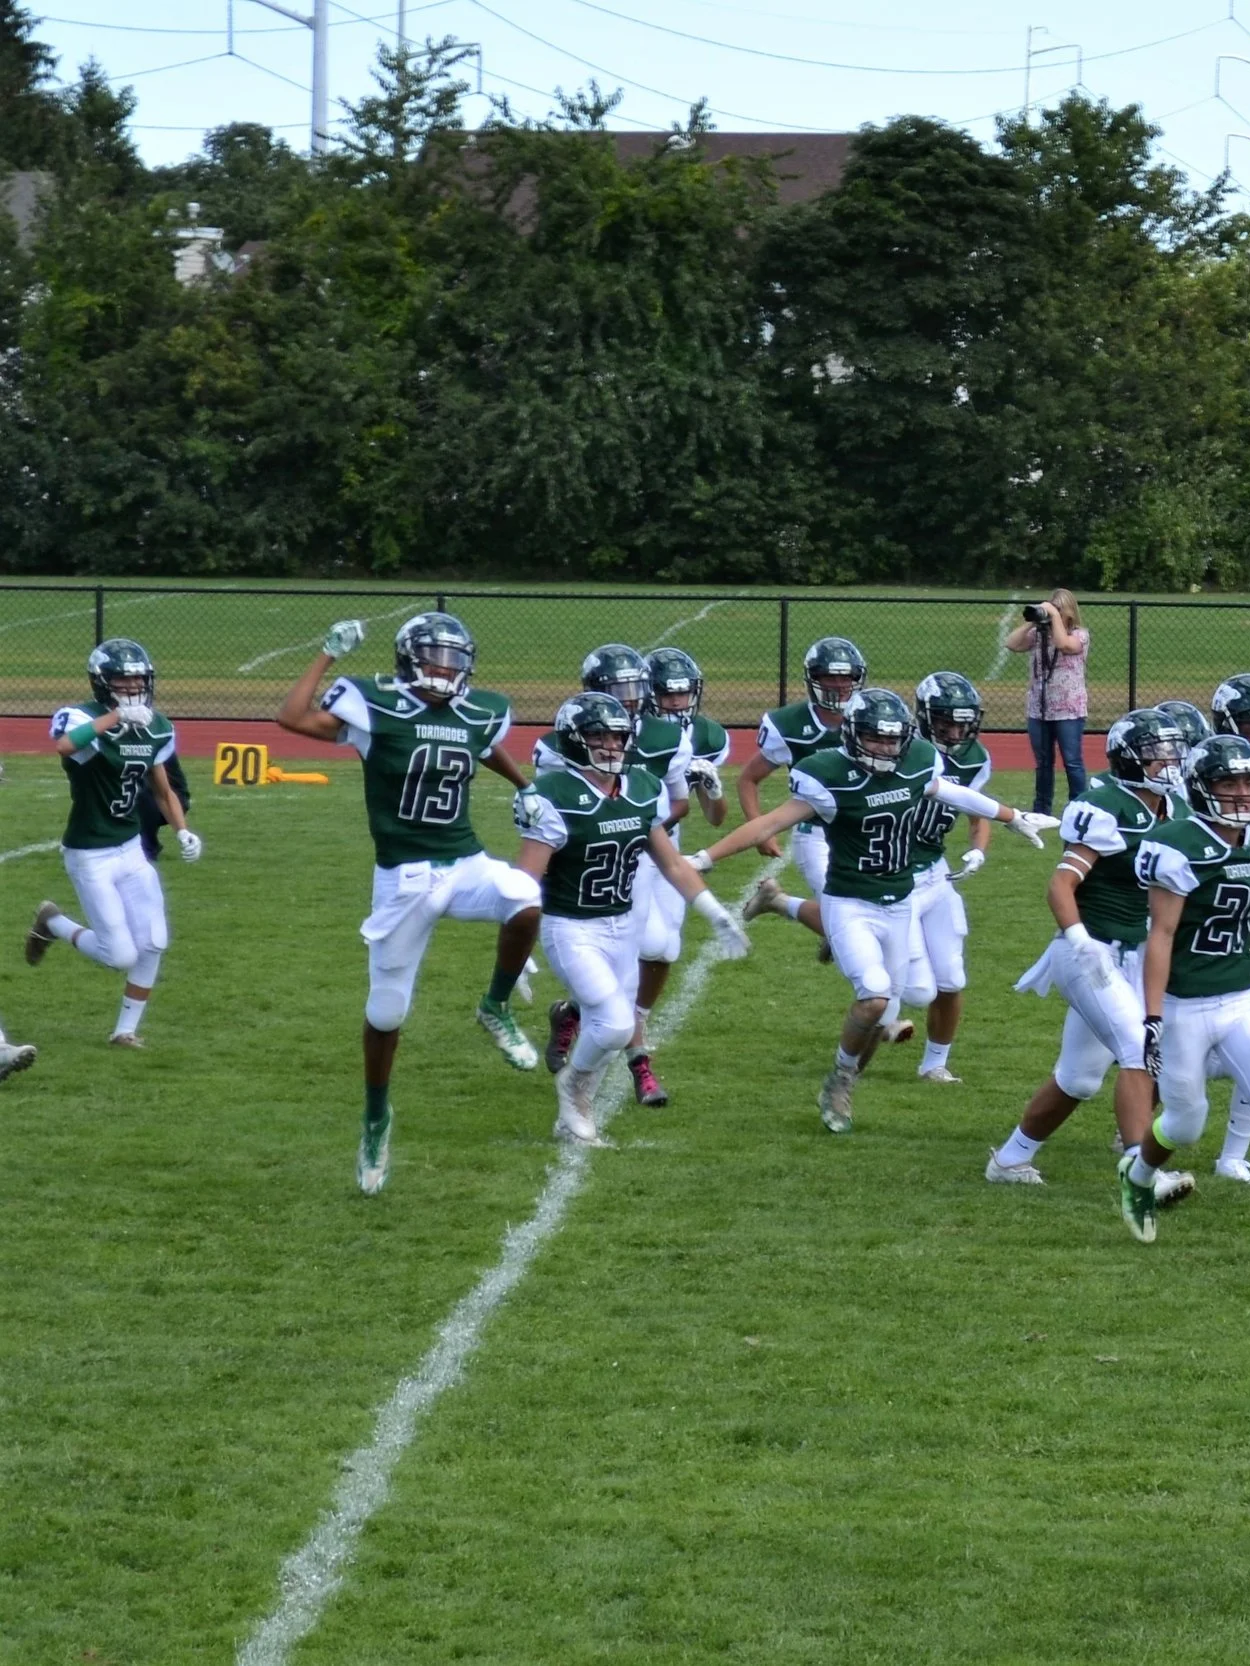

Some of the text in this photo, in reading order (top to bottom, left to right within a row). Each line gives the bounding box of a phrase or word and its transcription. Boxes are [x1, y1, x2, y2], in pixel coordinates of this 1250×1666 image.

[415, 723, 469, 743] TORNADOES
[221, 746, 261, 785] 20
[109, 760, 148, 818] 3
[398, 743, 473, 824] 13
[597, 816, 642, 835] TORNADOES
[1073, 810, 1094, 841] 4
